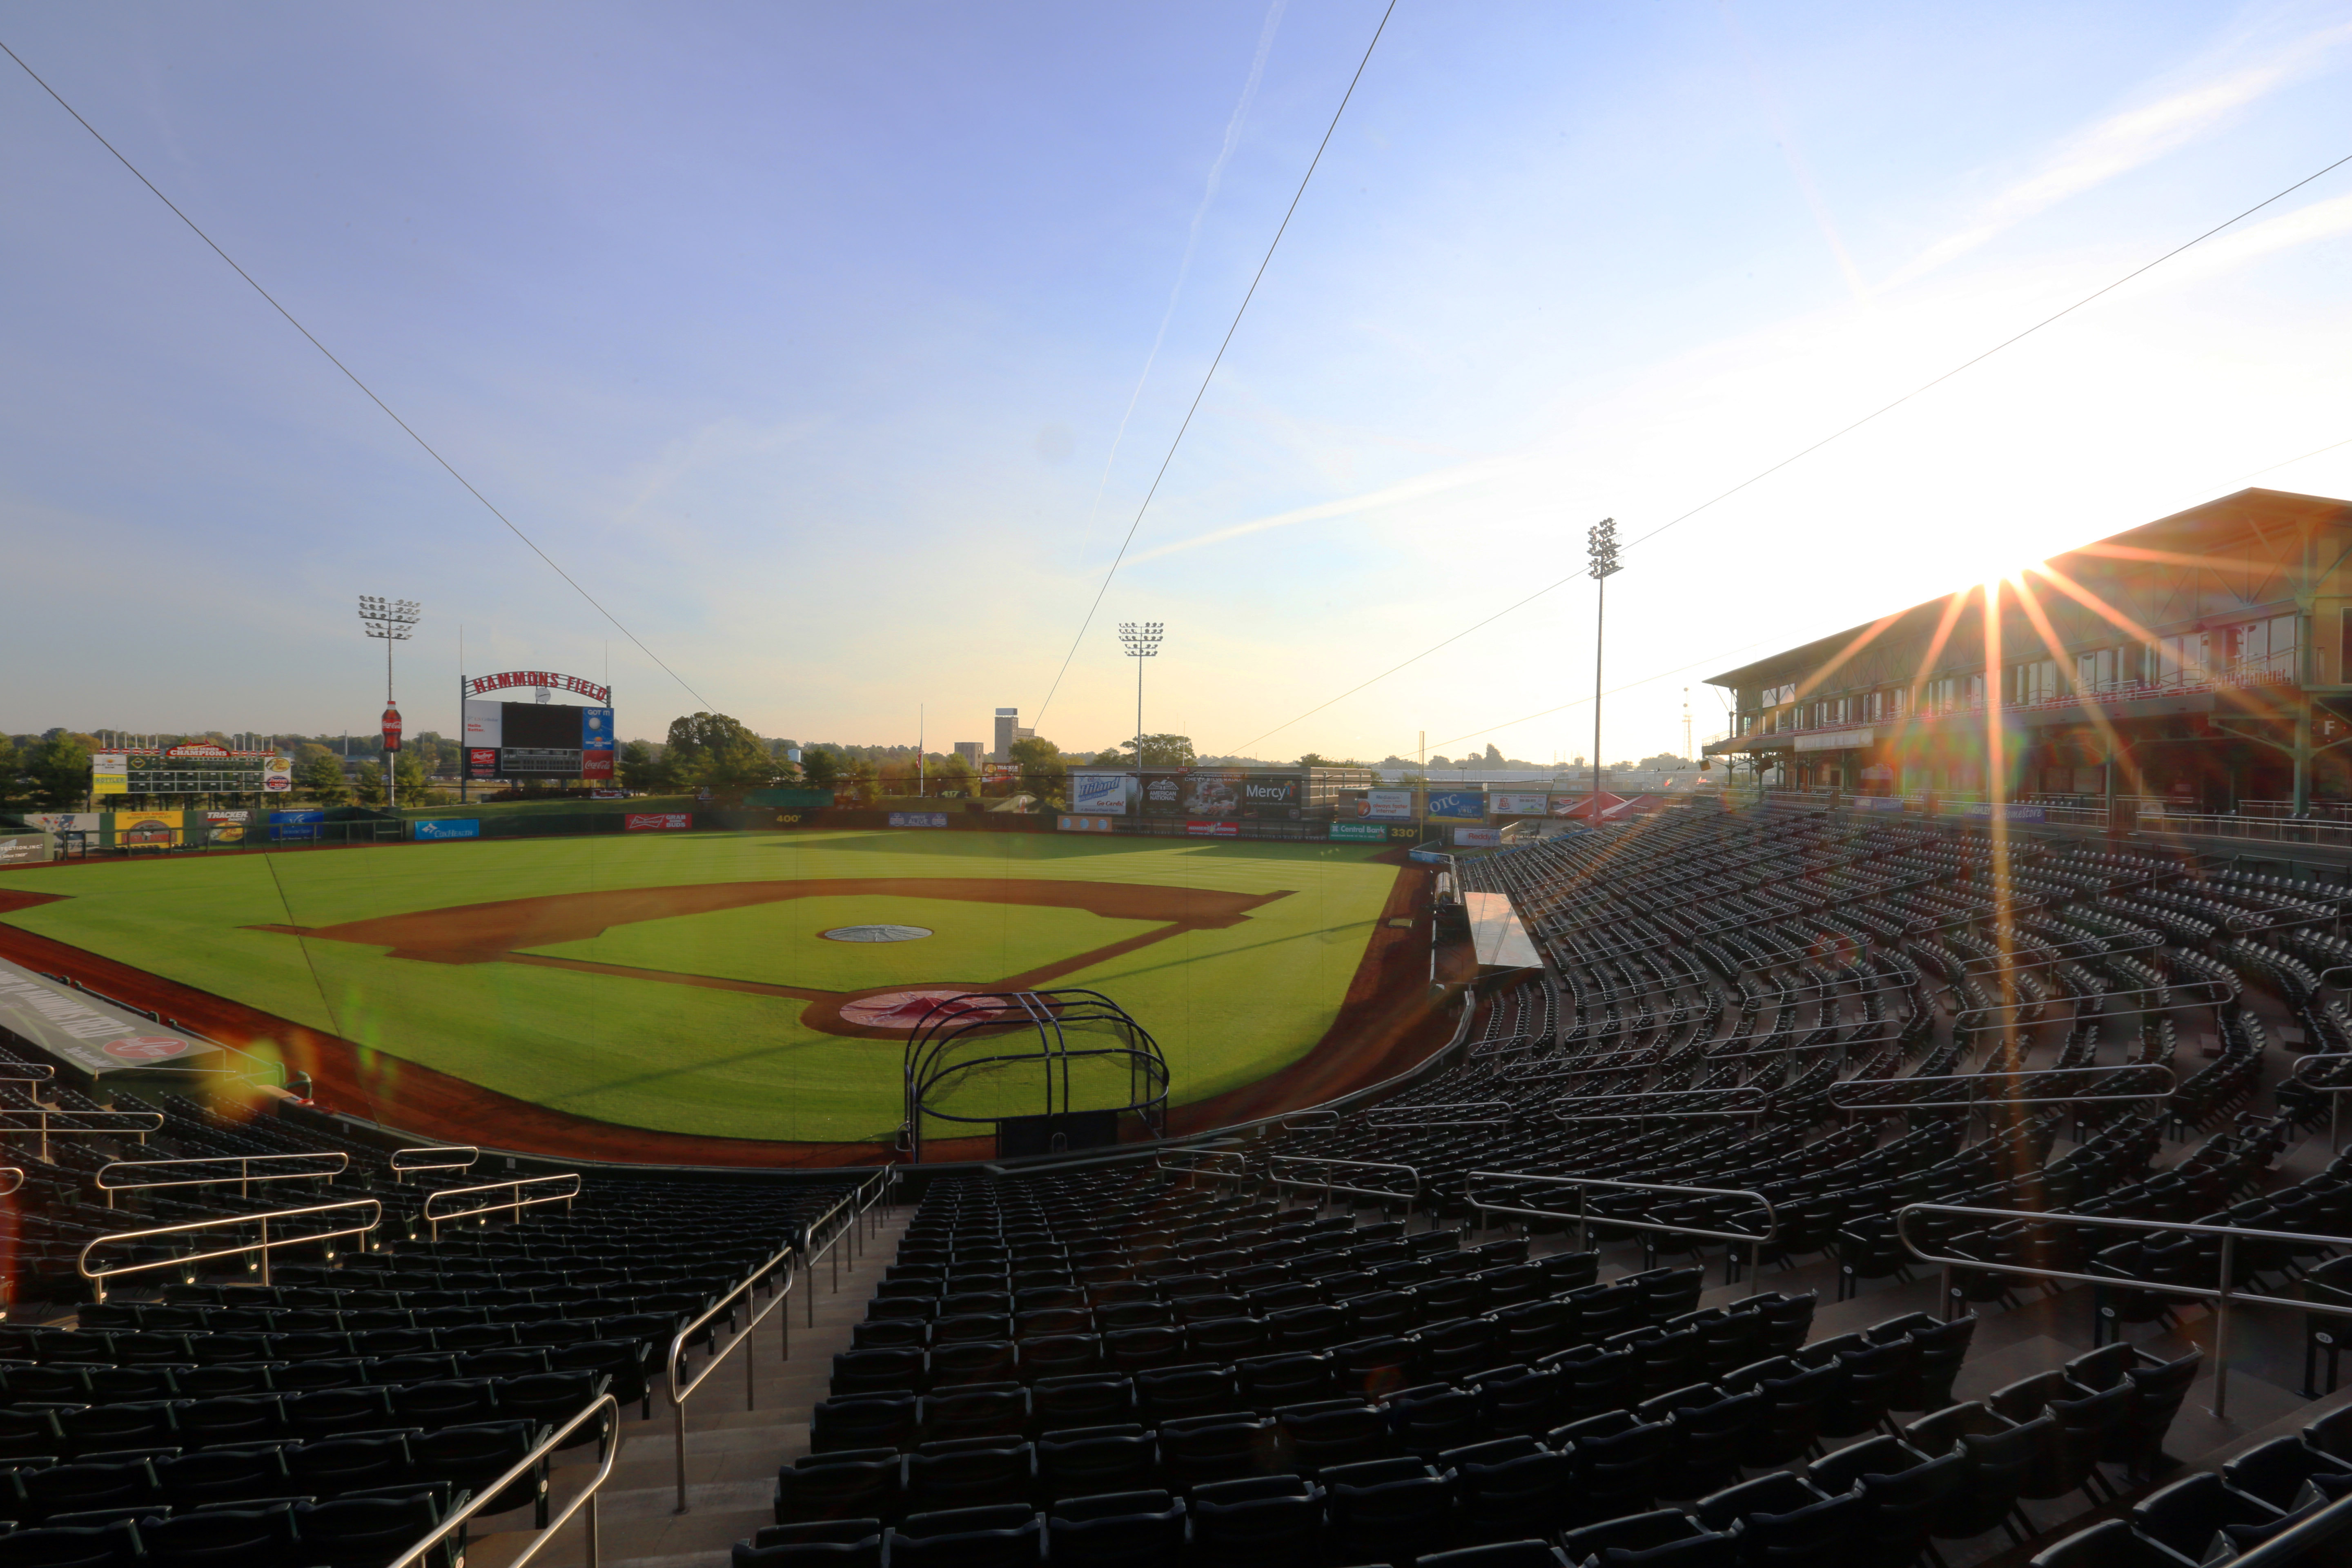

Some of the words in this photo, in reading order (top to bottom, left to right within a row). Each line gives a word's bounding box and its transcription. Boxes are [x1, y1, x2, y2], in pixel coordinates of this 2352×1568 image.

[473, 672, 559, 693] HAMMONS
[567, 676, 607, 701] FIELD
[2325, 721, 2335, 735] F
[585, 760, 610, 769] Coca-Cola
[1080, 776, 1120, 796] Hiland
[1247, 785, 1286, 800] Mercy
[1429, 794, 1459, 812] OTC
[1971, 806, 1991, 815] ASHLEY
[2002, 807, 2042, 819] HomeStore
[1391, 828, 1418, 837] 330'
[15, 989, 100, 1020] HAMMONS
[56, 1016, 136, 1039] FIELD
[116, 1041, 179, 1056] Cutter
